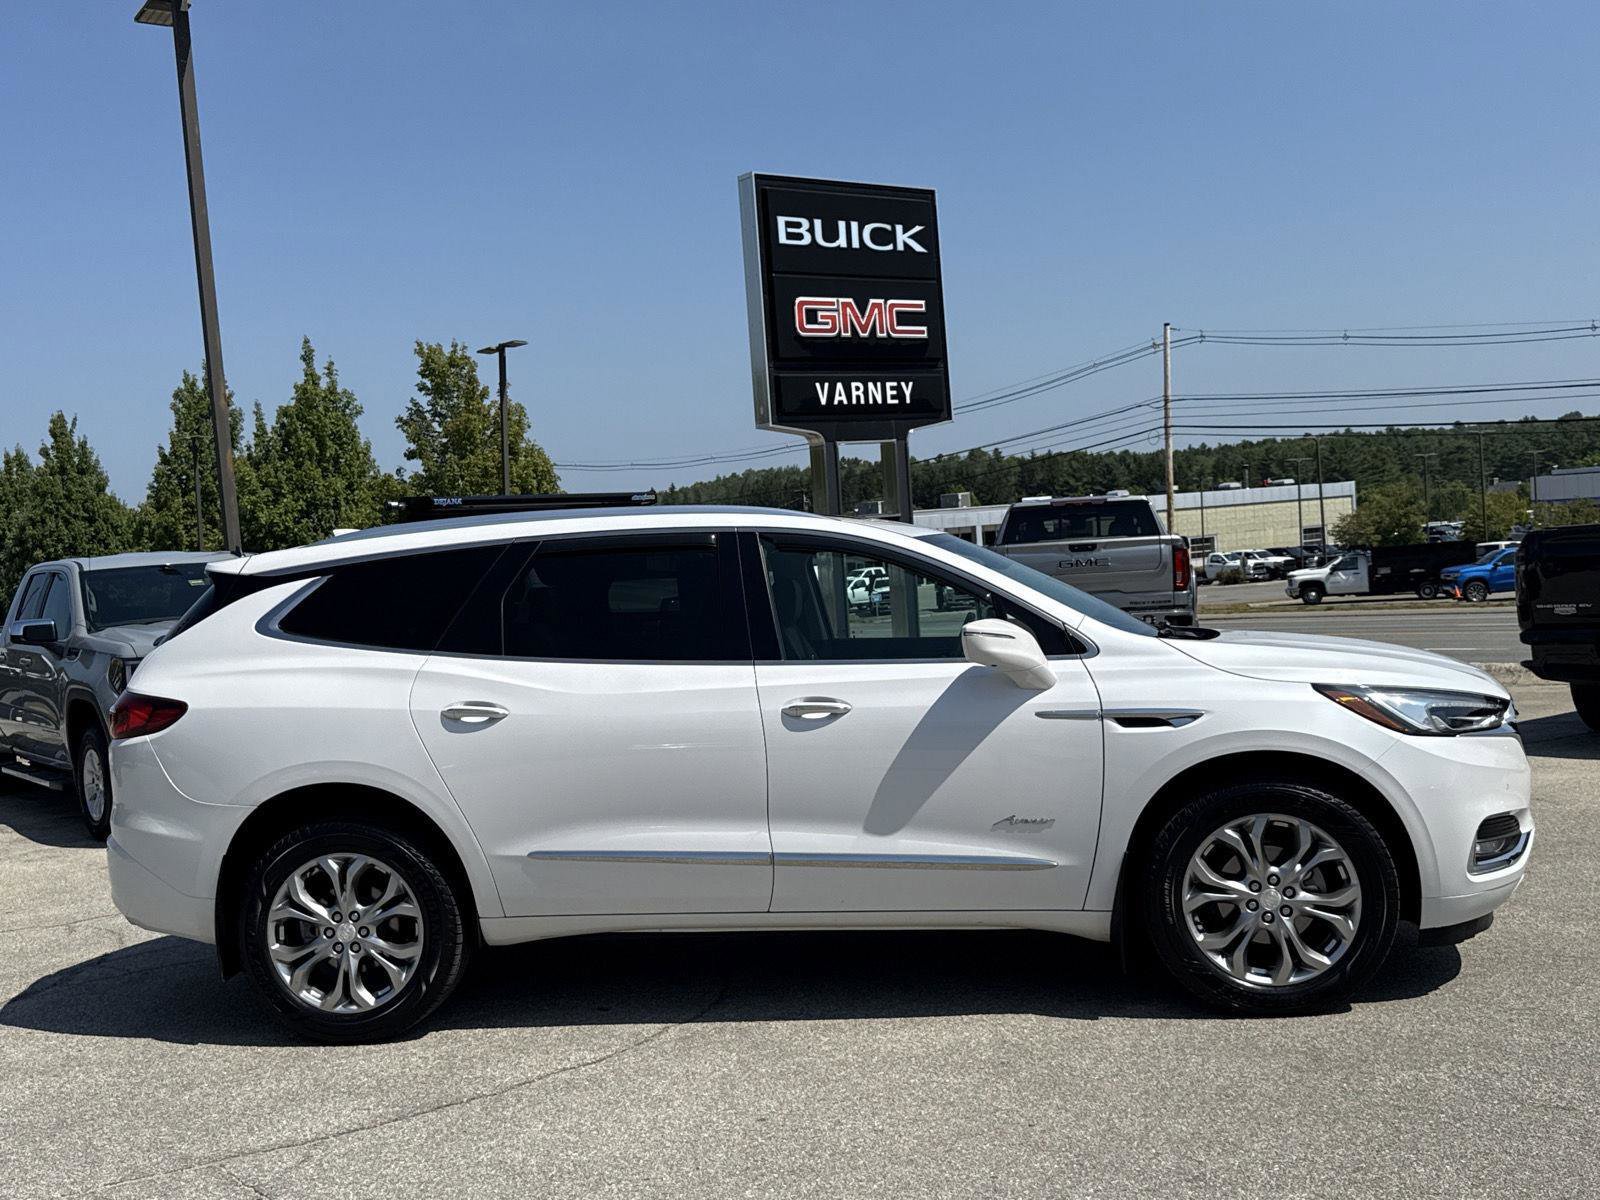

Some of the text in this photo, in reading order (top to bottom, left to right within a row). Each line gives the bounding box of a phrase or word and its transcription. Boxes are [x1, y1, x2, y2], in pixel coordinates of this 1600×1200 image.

[776, 215, 928, 253] BUICK
[794, 296, 928, 338] GMC
[815, 381, 914, 405] VARNEY
[1058, 558, 1112, 568] GMC
